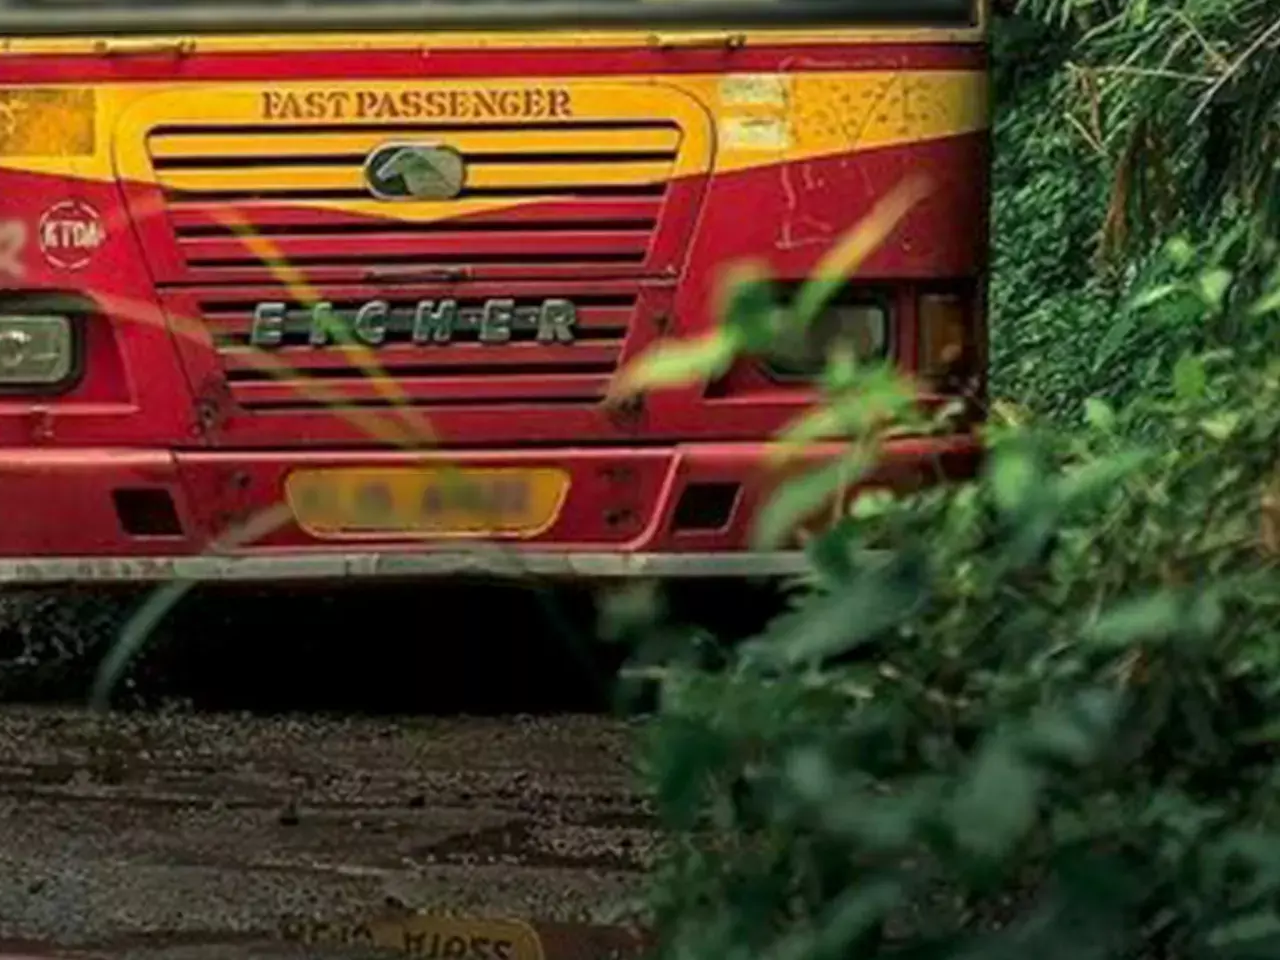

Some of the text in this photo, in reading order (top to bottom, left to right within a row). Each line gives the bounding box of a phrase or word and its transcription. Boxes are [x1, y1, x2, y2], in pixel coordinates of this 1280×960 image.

[261, 87, 572, 119] FAST PASSENGER
[251, 298, 577, 346] EICHER
